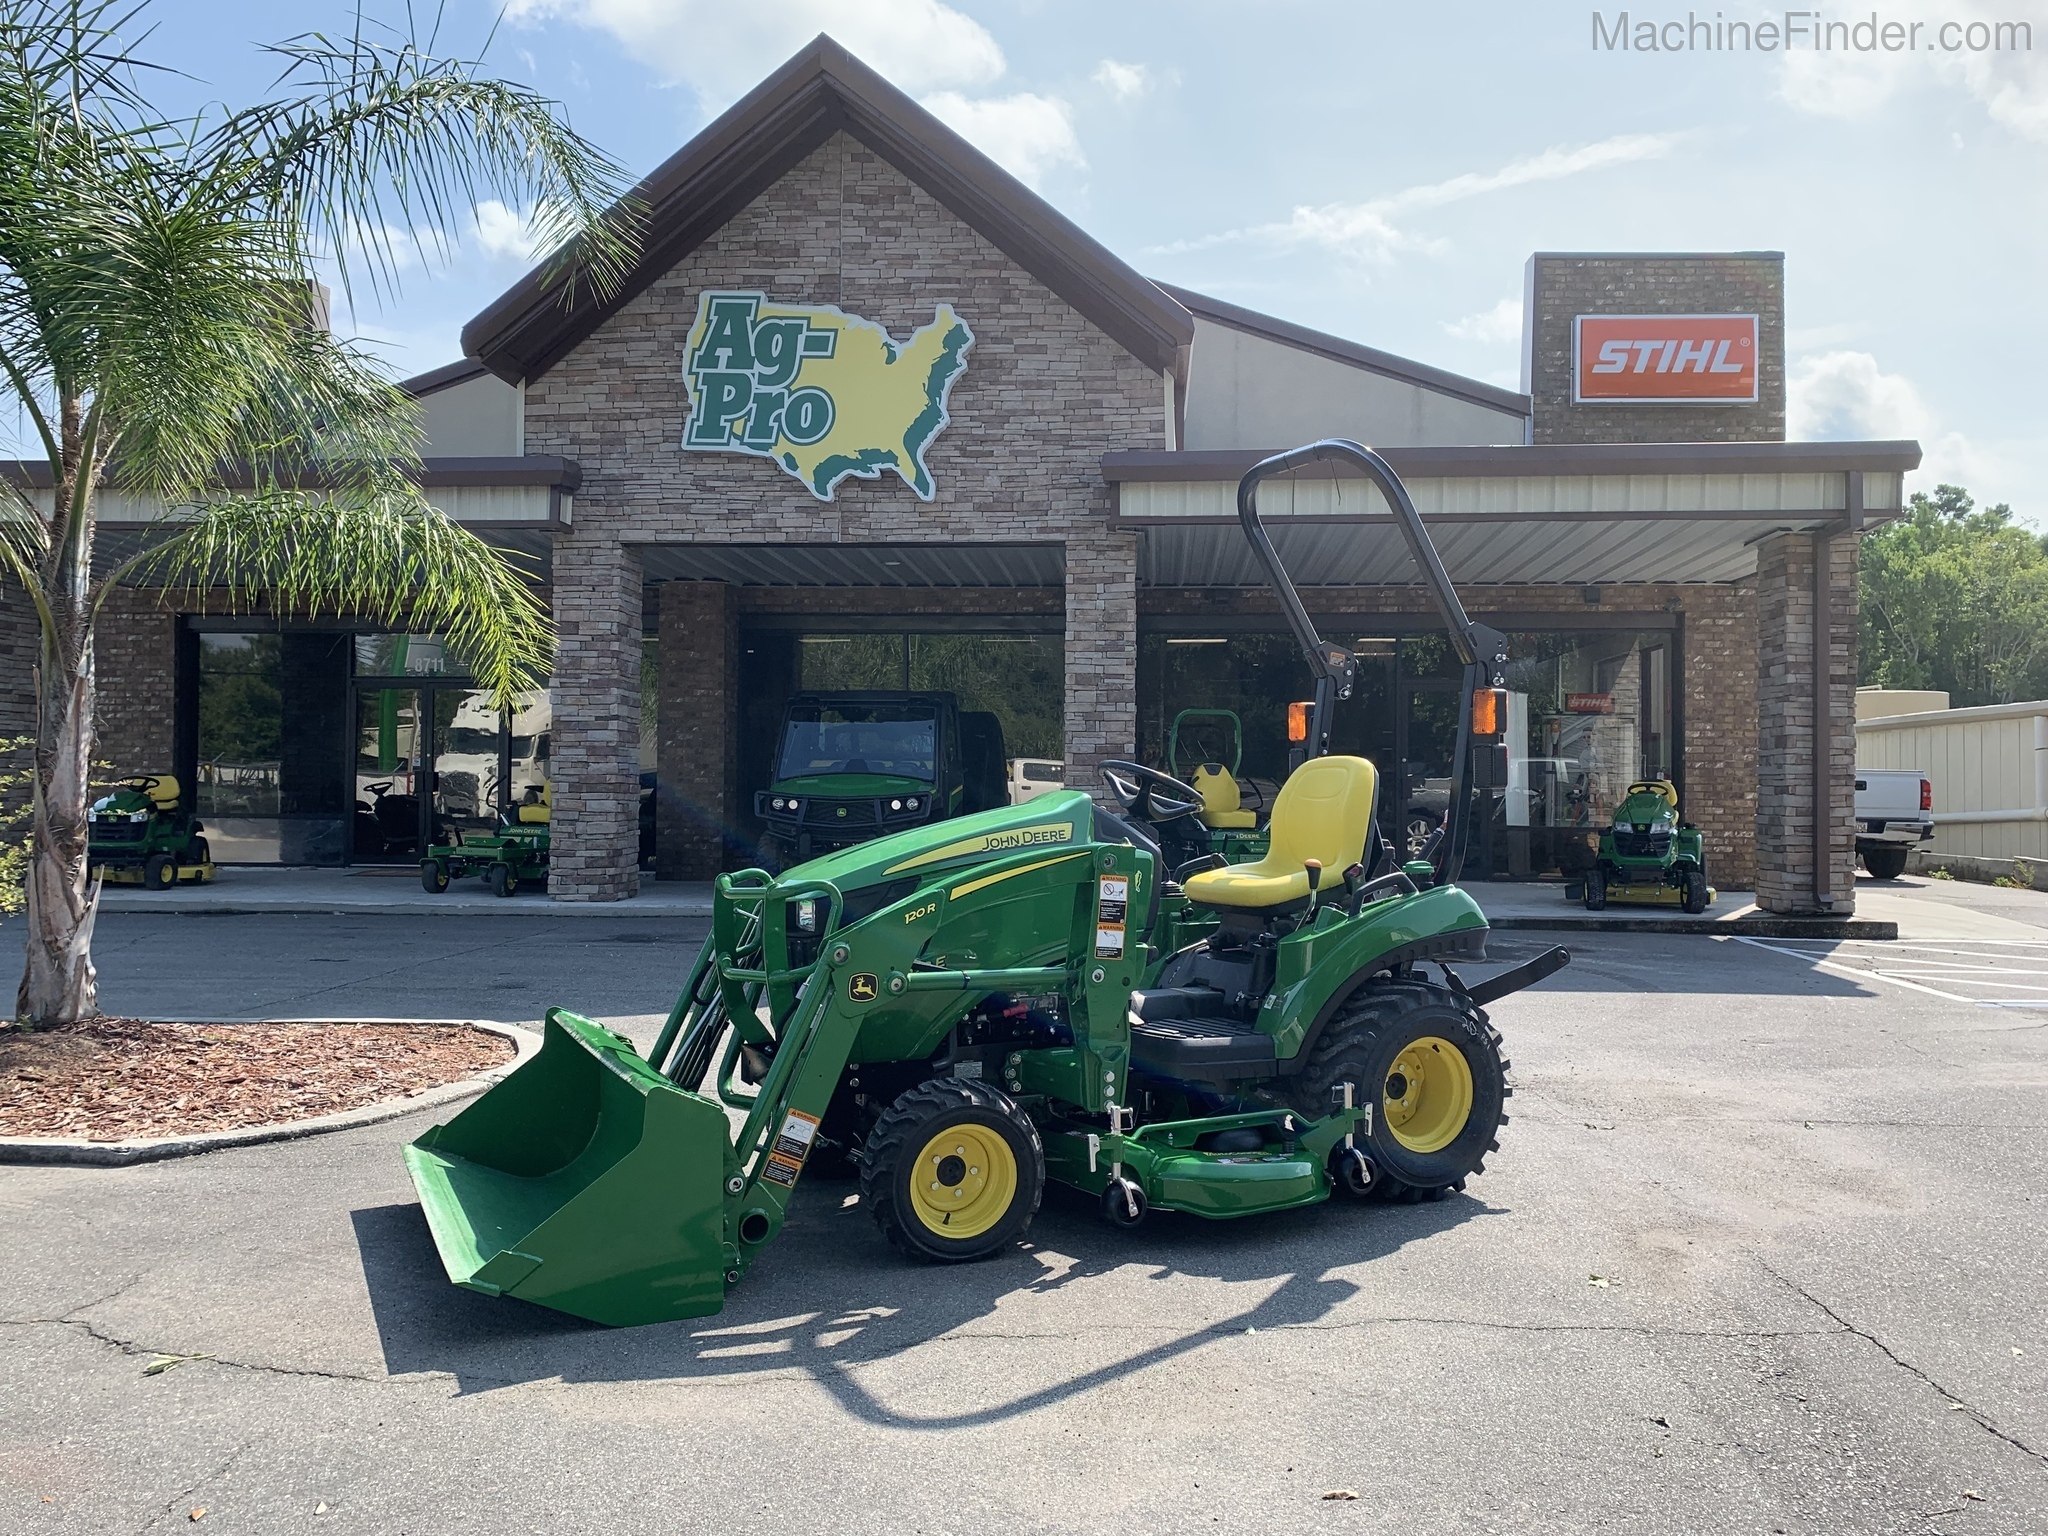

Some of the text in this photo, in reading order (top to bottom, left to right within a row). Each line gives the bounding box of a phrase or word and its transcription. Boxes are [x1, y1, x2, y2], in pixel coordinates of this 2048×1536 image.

[690, 297, 836, 389] Ag-
[1592, 339, 1745, 374] STIHL
[689, 371, 834, 444] Pro
[414, 657, 444, 673] 8711
[1570, 698, 1609, 708] STIHL
[982, 829, 1067, 851] JOHN DEERE
[904, 903, 936, 925] 120 R
[1102, 924, 1124, 932] WARNING
[796, 1112, 817, 1123] WARNING
[779, 1157, 798, 1167] WARNING
